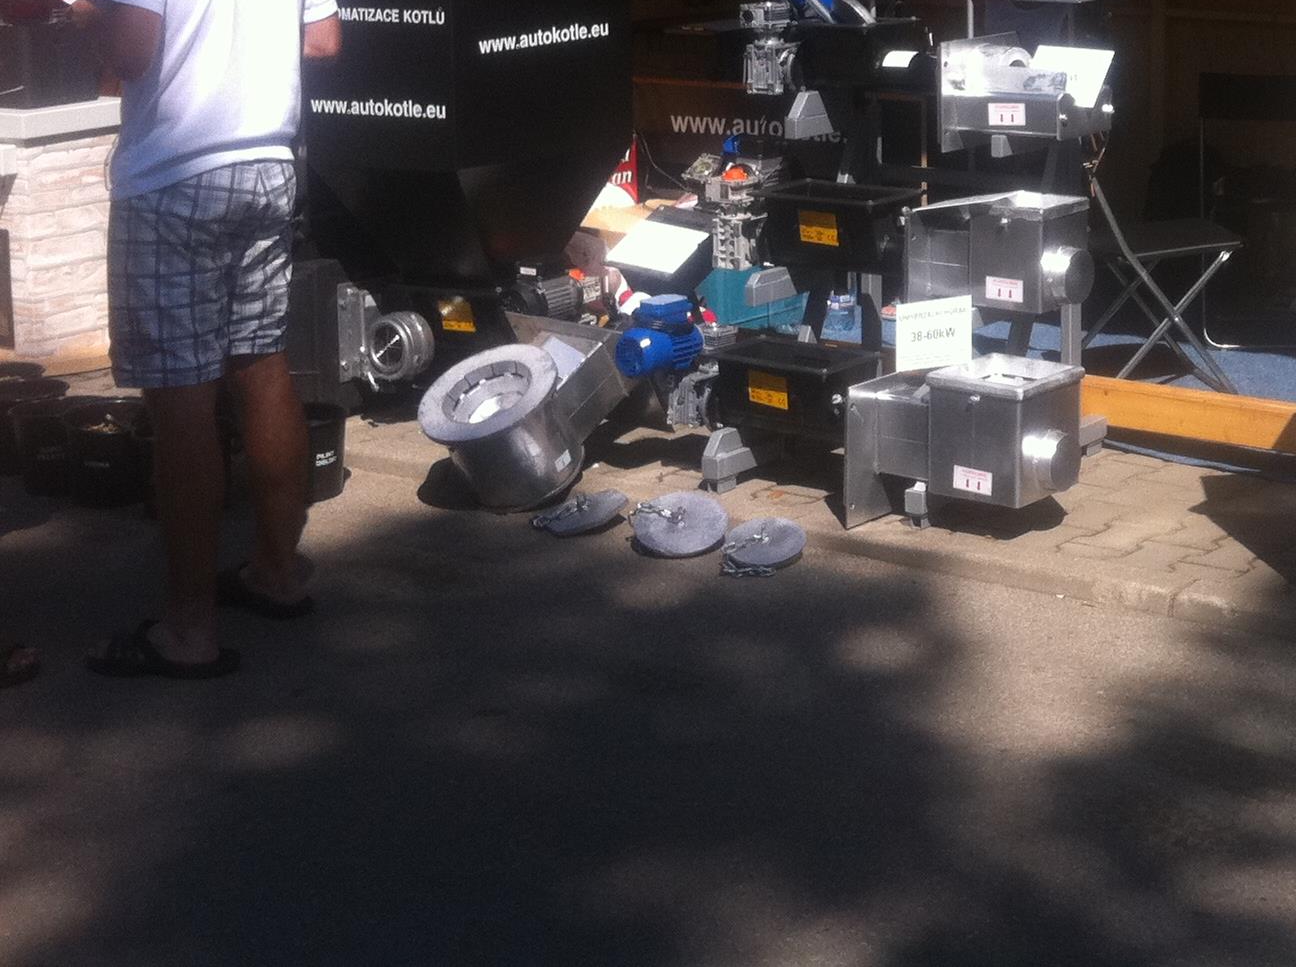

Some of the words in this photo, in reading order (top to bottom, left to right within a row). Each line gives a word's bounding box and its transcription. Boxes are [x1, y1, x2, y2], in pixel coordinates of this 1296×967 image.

[337, 7, 399, 23] MATIZACE
[478, 22, 609, 55] www.autokotle.eu
[311, 98, 446, 120] www.autokotle.eu
